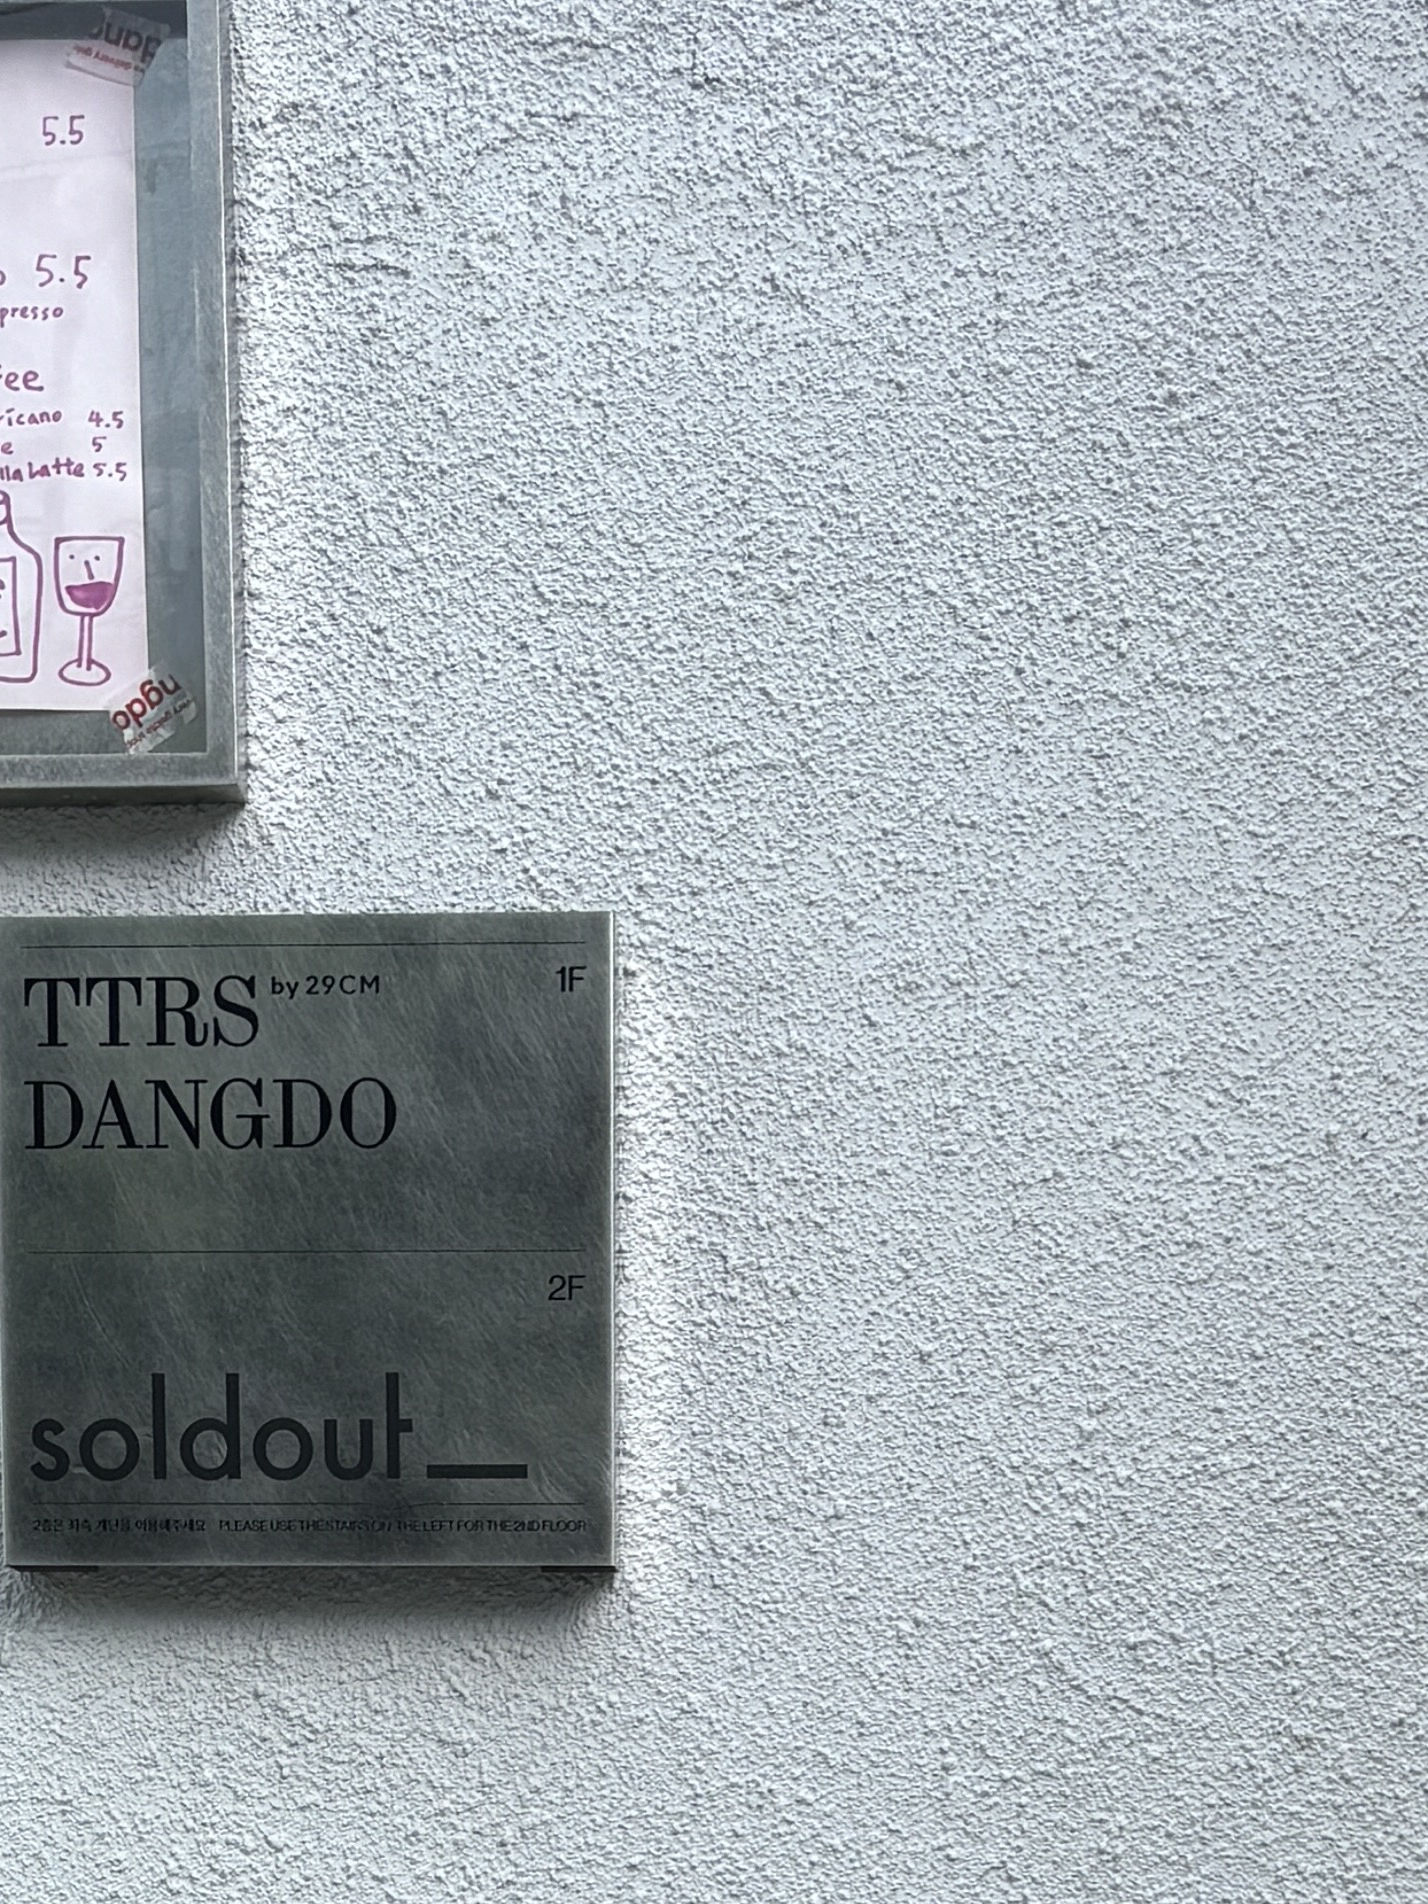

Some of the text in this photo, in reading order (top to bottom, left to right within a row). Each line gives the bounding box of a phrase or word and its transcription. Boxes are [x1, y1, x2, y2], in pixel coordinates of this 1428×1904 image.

[42, 115, 85, 146] 5.5
[35, 254, 91, 289] 5.5
[87, 410, 125, 429] 4.5
[92, 436, 107, 453] 5
[92, 462, 128, 482] 5.5
[554, 966, 587, 993] 1F
[23, 974, 381, 1049] TTRS by 29CM
[24, 1076, 398, 1150] DANGDO
[547, 1275, 587, 1302] 2F
[219, 1519, 587, 1532] PLEASE USE THE STAIRS ON THE LEFT FOR THE 2ND FLOOR
